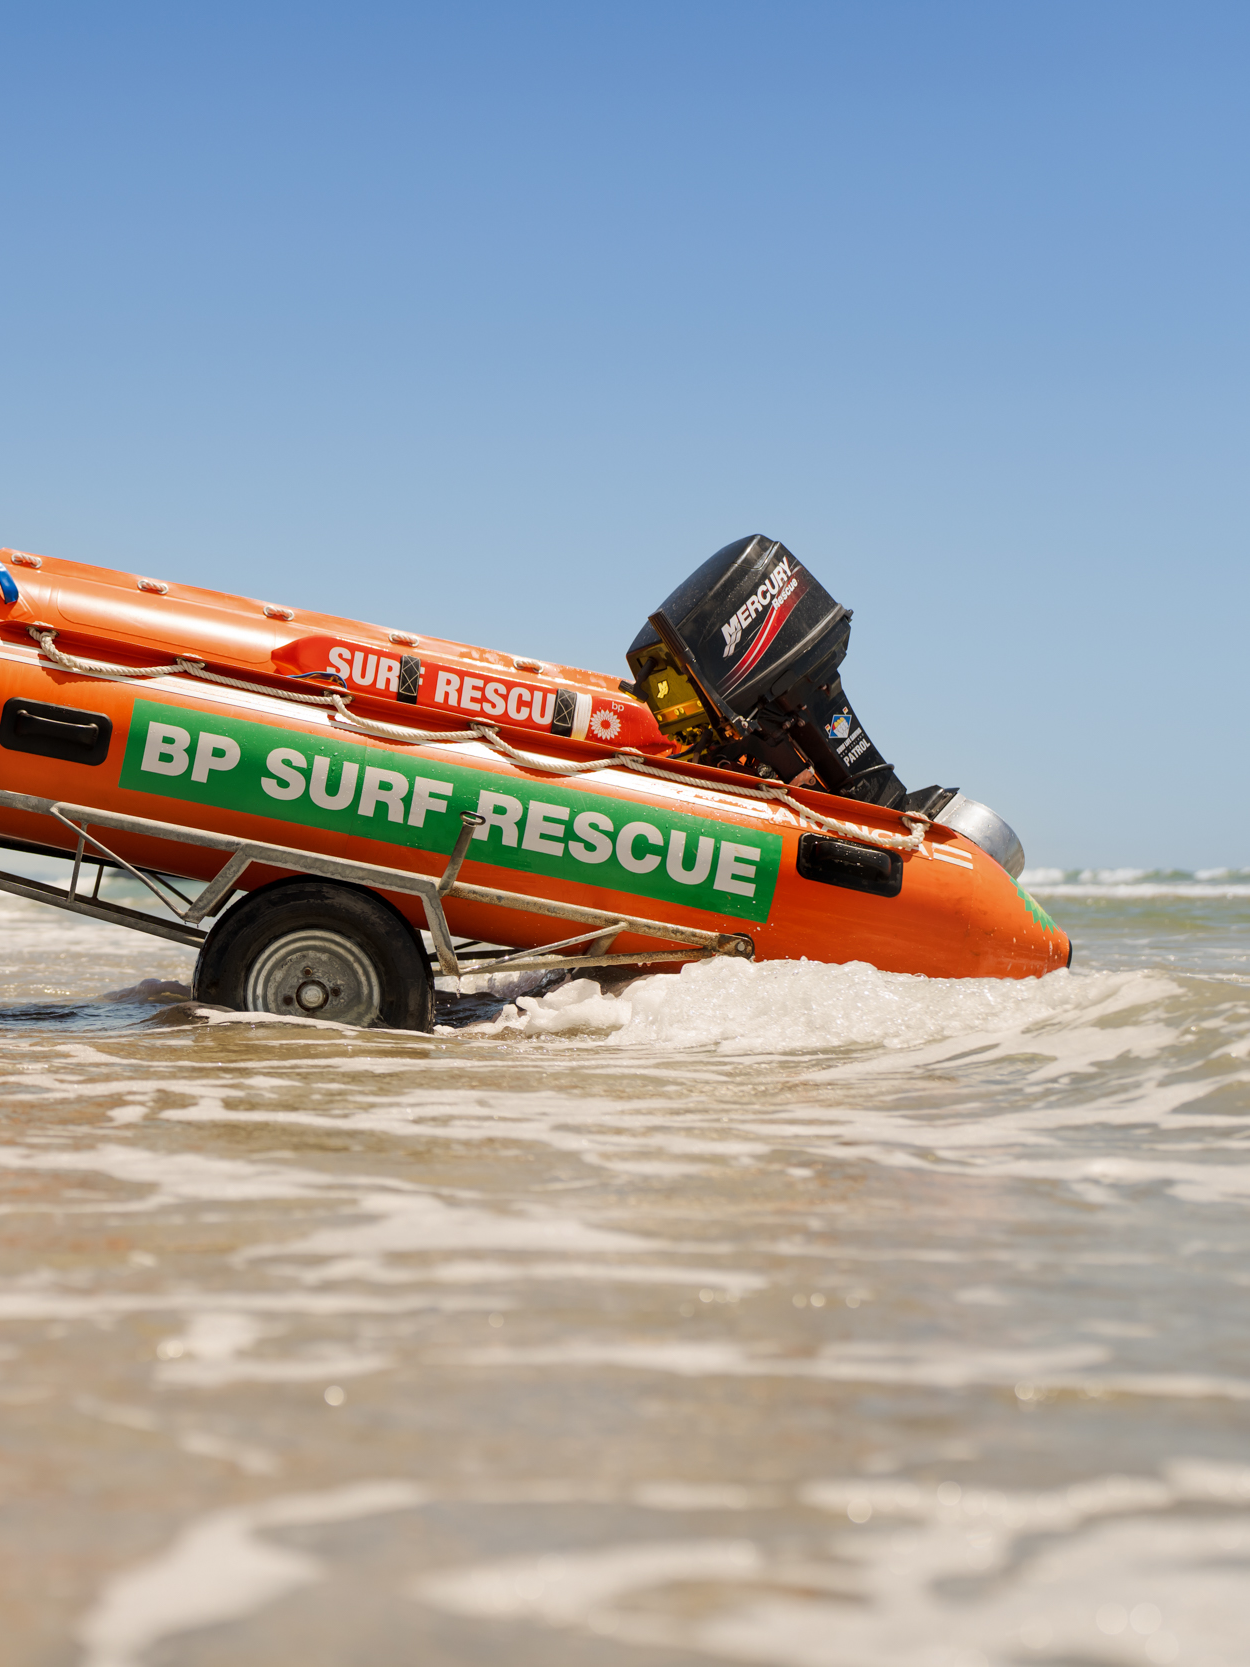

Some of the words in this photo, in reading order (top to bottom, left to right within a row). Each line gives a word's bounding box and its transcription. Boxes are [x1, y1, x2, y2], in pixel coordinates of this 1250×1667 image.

[721, 555, 792, 658] MERCURY
[771, 578, 798, 611] Rescue
[326, 646, 425, 693] SUR
[434, 670, 556, 725] RESCU
[612, 701, 624, 713] bp
[843, 738, 871, 767] PATROL
[141, 720, 241, 784] BP
[261, 747, 454, 828] SURF
[472, 789, 761, 897] RESCUE
